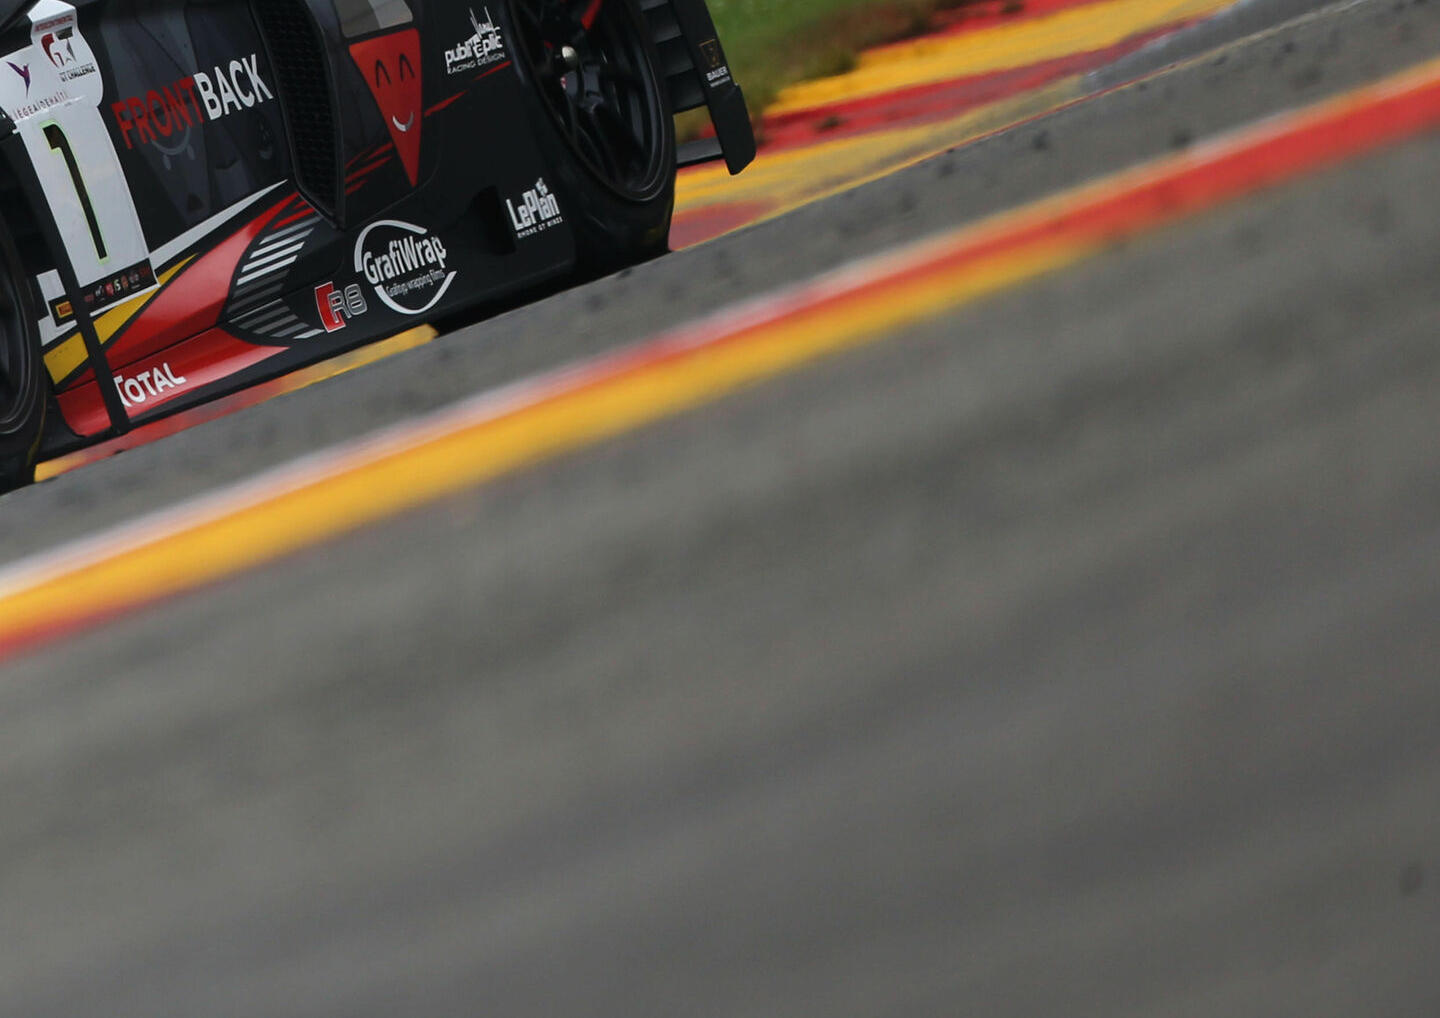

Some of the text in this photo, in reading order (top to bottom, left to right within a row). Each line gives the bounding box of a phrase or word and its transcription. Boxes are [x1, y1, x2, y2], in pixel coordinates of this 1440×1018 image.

[39, 118, 110, 265] 1
[505, 188, 560, 231] LePlan
[363, 234, 447, 284] GrafiWrap
[114, 362, 187, 407] TOTAL
